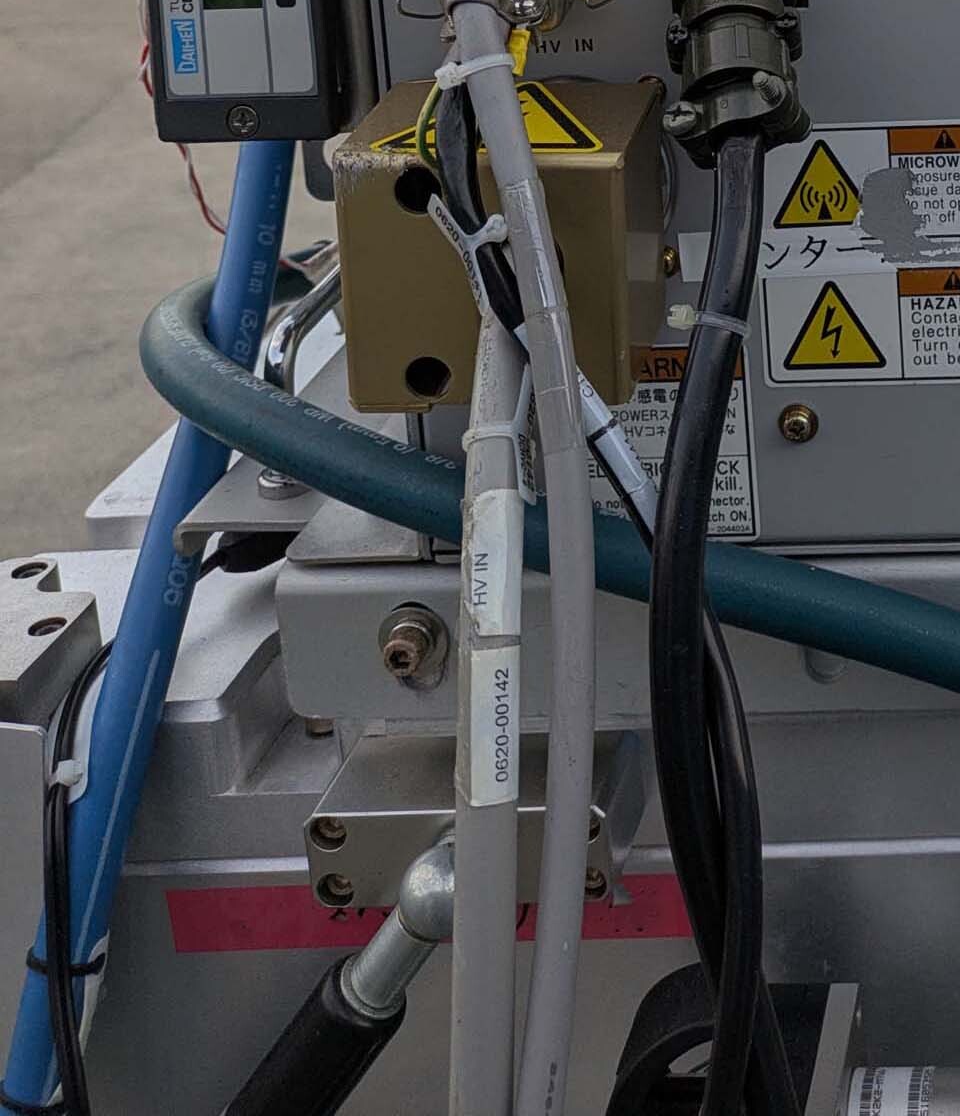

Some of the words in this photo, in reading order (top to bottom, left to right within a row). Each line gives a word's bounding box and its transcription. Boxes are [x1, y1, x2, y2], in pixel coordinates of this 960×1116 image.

[172, 20, 198, 73] DAIHEN
[535, 40, 561, 55] HV
[575, 38, 594, 53] IN
[912, 171, 960, 184] posure
[924, 198, 944, 209] not
[939, 211, 956, 223] off
[912, 339, 949, 352] Turn
[913, 353, 938, 365] out
[715, 477, 743, 492] kill.
[475, 552, 488, 573] IN
[473, 578, 488, 606] HV
[495, 667, 510, 783] 0620-00142
